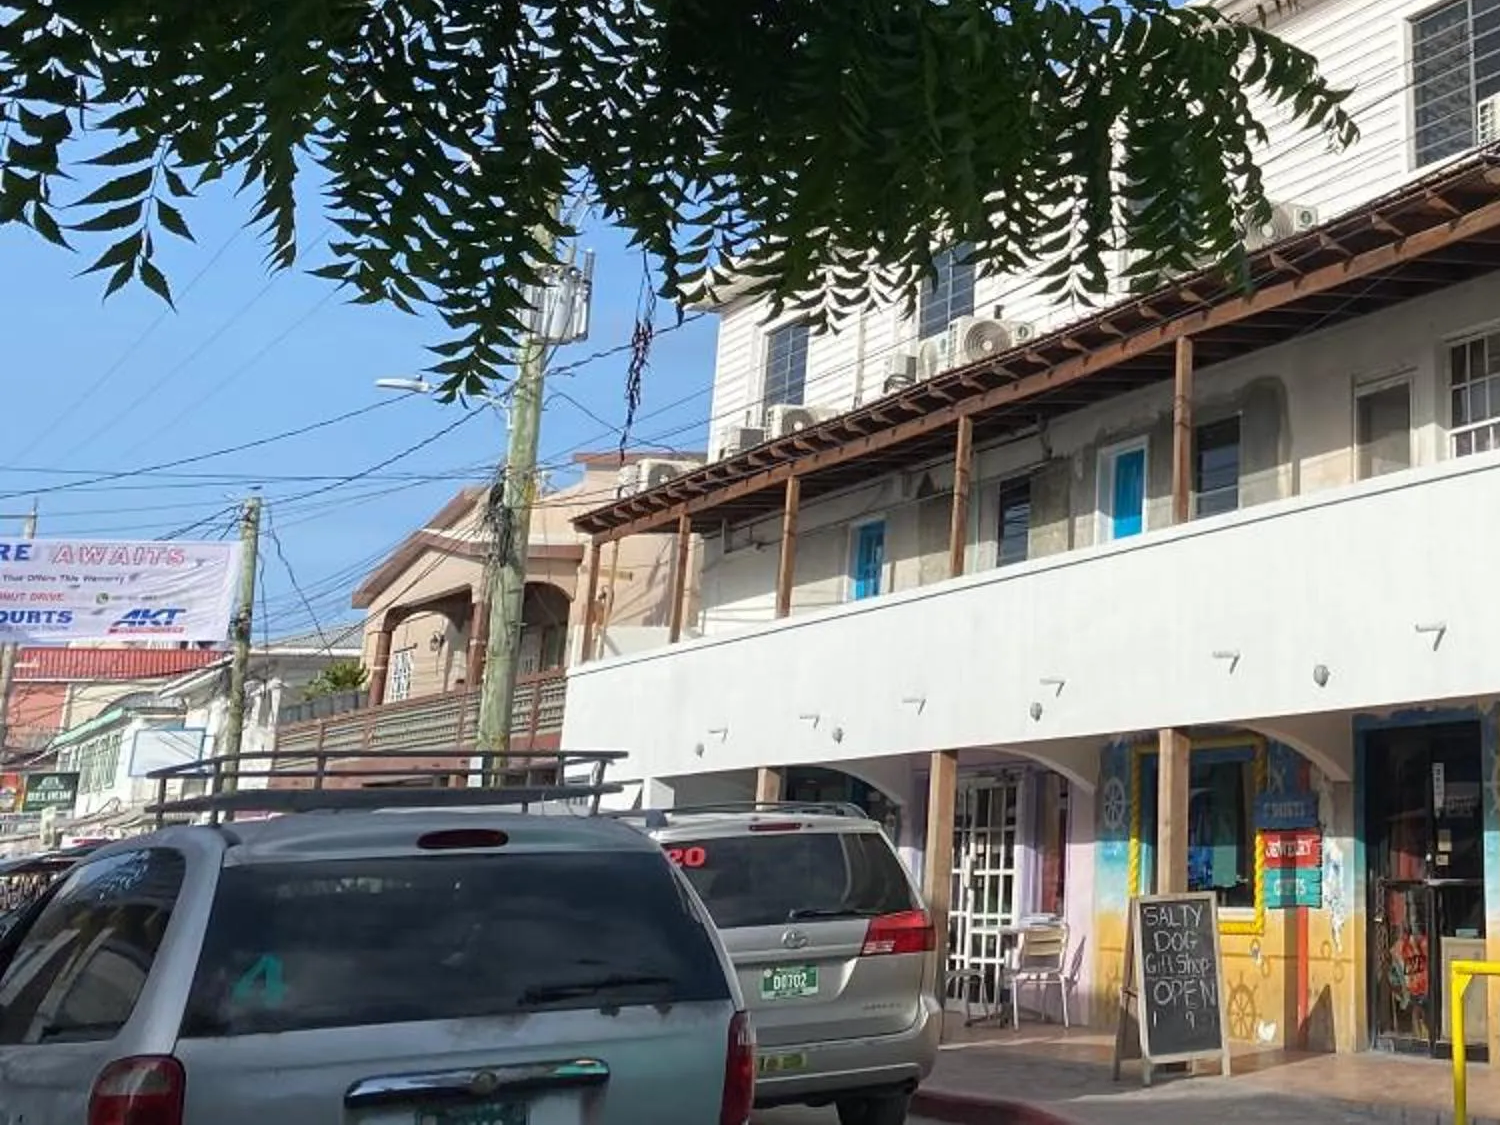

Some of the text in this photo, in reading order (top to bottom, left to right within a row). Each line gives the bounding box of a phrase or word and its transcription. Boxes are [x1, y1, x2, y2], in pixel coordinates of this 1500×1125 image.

[52, 545, 186, 566] AWAITS
[1143, 905, 1203, 928] SALTY
[1153, 929, 1198, 952] DOG
[1153, 979, 1217, 1009] OPEN
